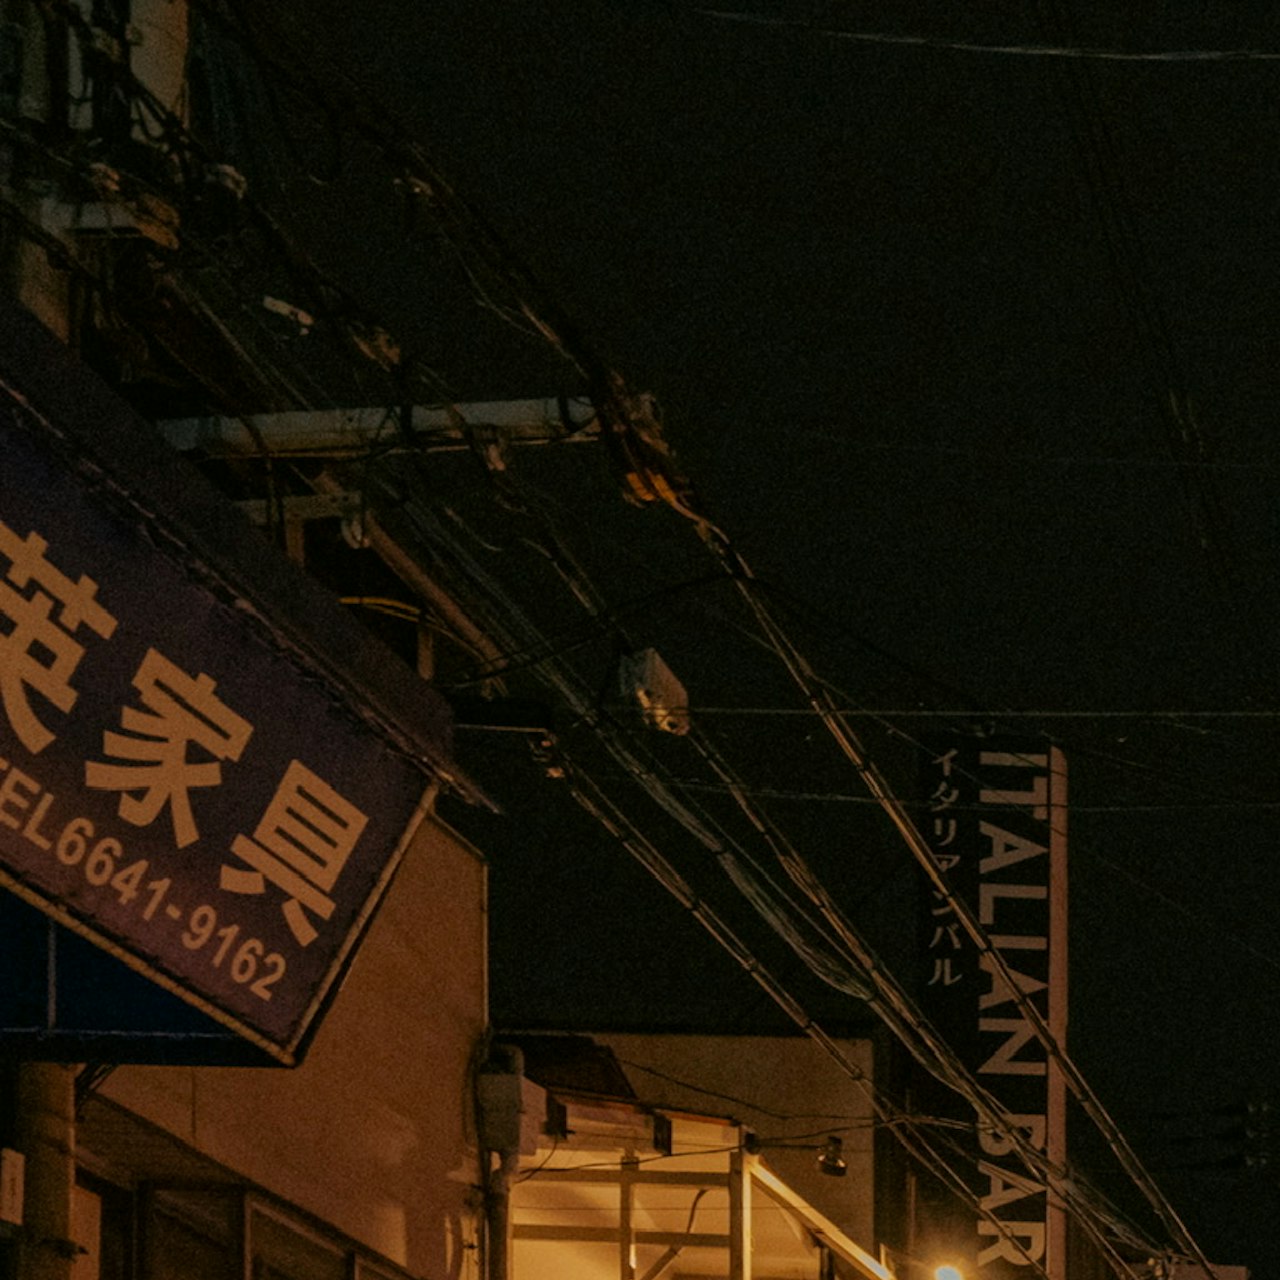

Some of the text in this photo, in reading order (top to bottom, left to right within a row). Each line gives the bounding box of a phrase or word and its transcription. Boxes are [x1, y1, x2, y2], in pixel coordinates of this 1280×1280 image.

[0, 755, 287, 1001] EL6641-9162
[928, 748, 962, 987] イタリアンバル
[976, 750, 1049, 1268] ITALIAN BAR
